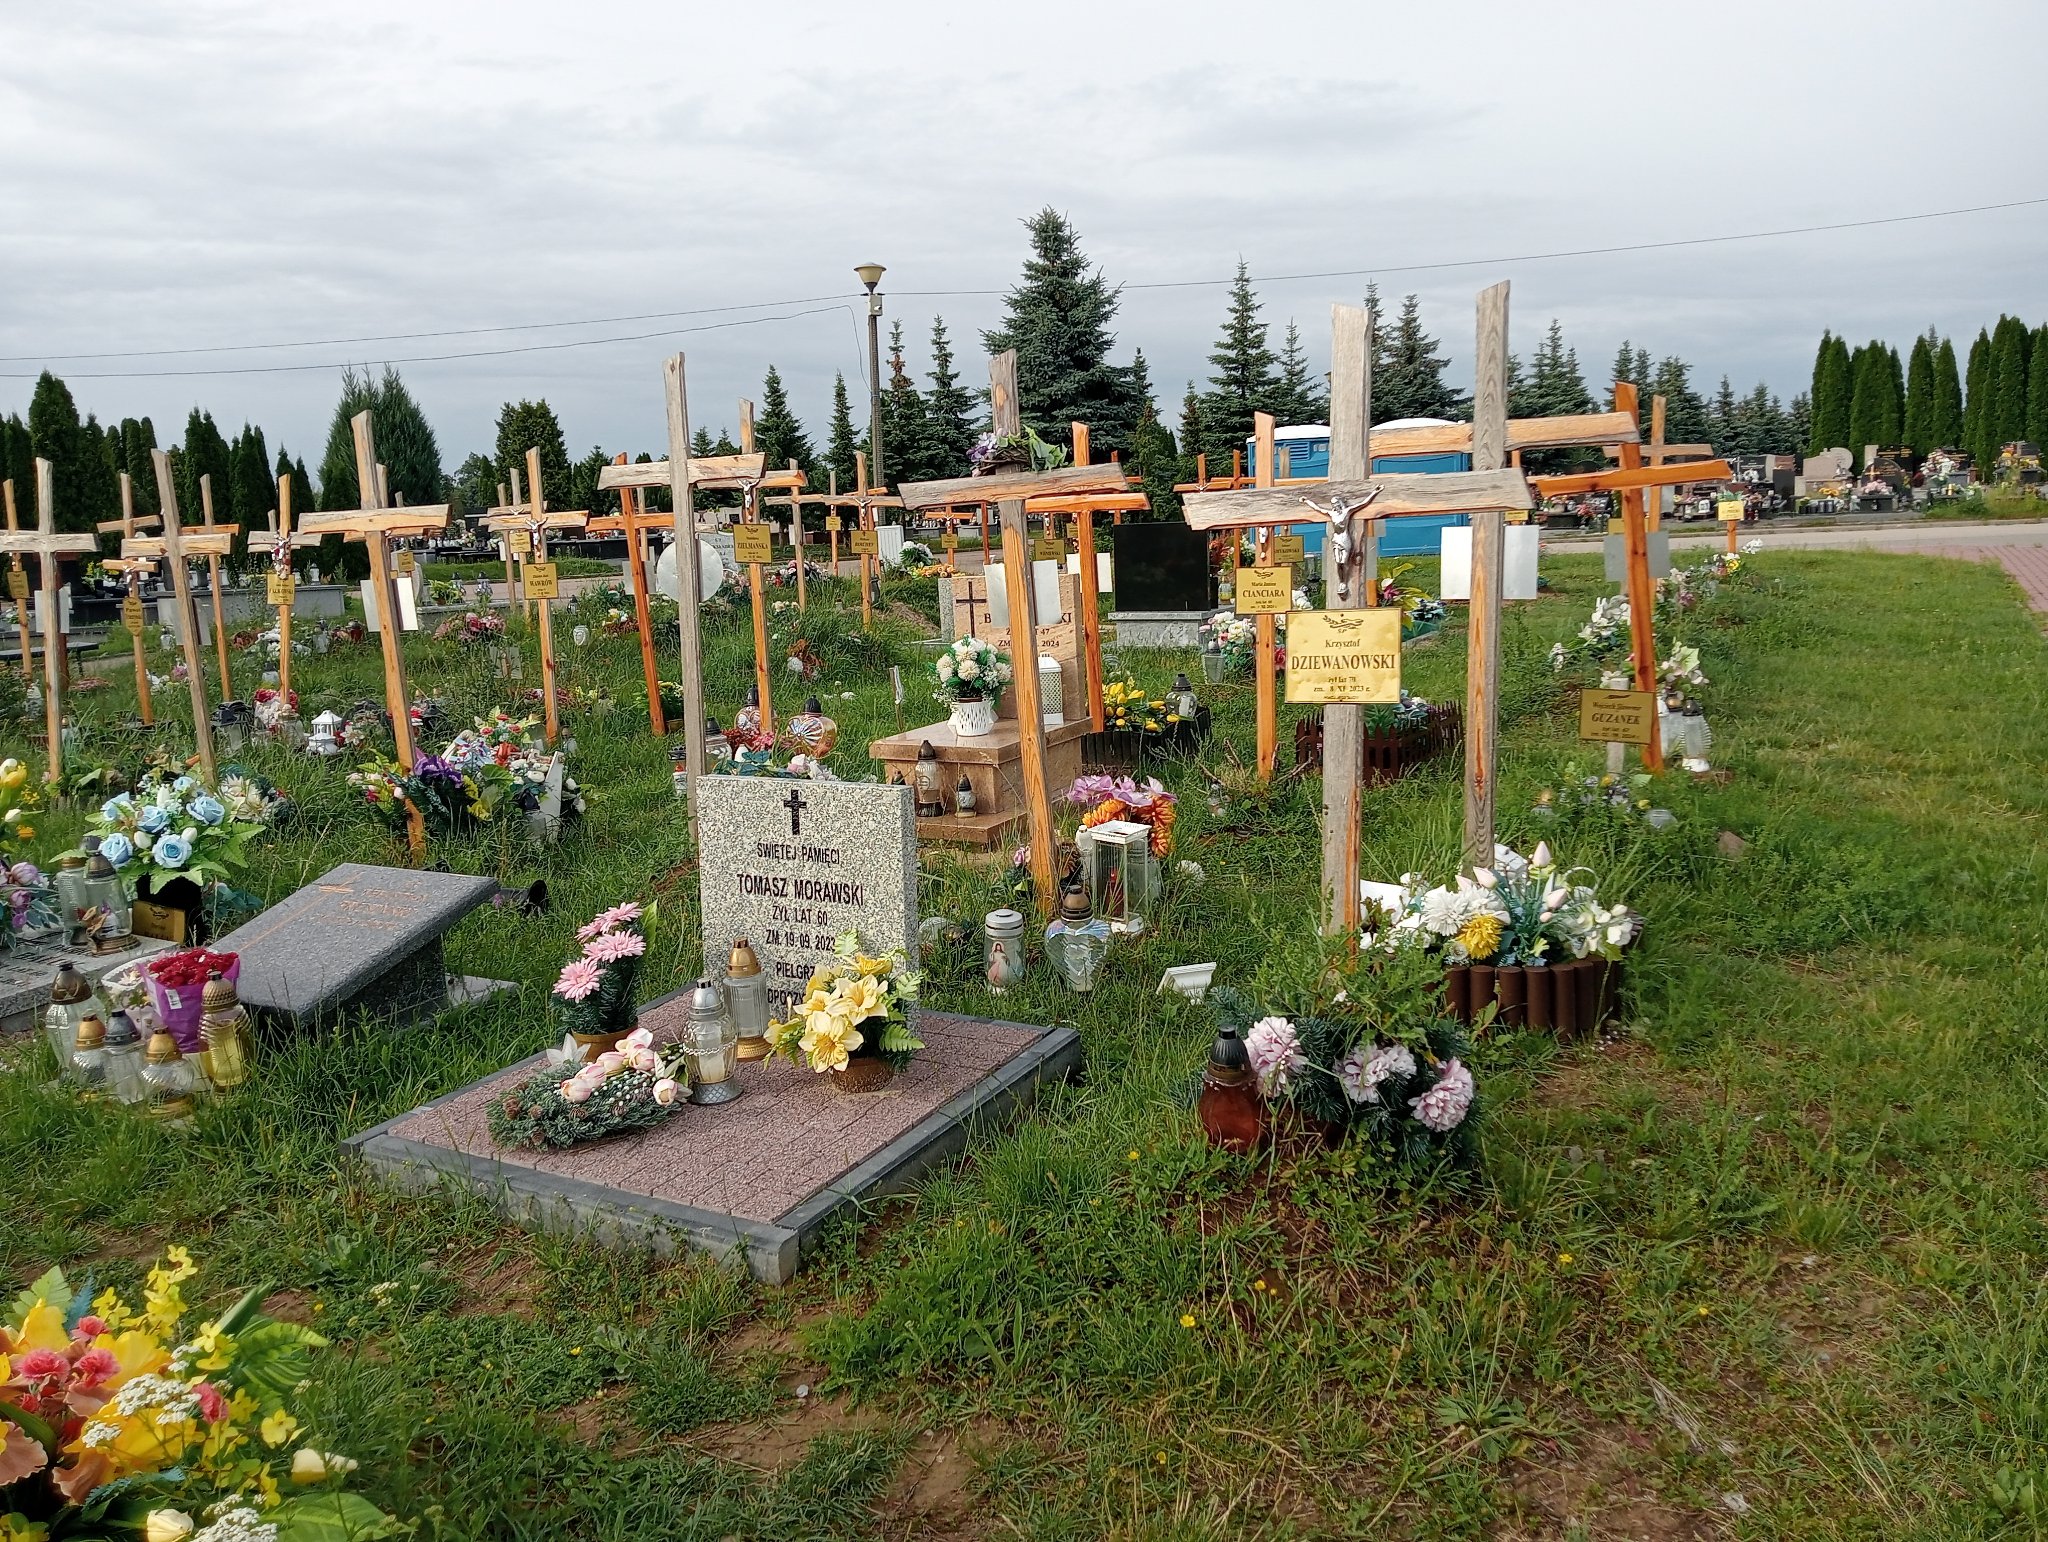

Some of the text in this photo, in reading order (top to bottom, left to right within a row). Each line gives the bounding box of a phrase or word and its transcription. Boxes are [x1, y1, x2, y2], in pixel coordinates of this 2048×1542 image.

[1242, 589, 1286, 598] CIANCIARA
[1041, 640, 1060, 648] 2024
[1325, 638, 1361, 650] Krzysztof
[1291, 654, 1396, 671] DZIEWANOWSKI
[1591, 712, 1641, 725] GUZANEK
[801, 844, 840, 868] PAMIĘCI
[737, 873, 864, 907] TOMASZ MORAWSKI
[795, 908, 812, 924] LAT
[818, 910, 828, 926] 60
